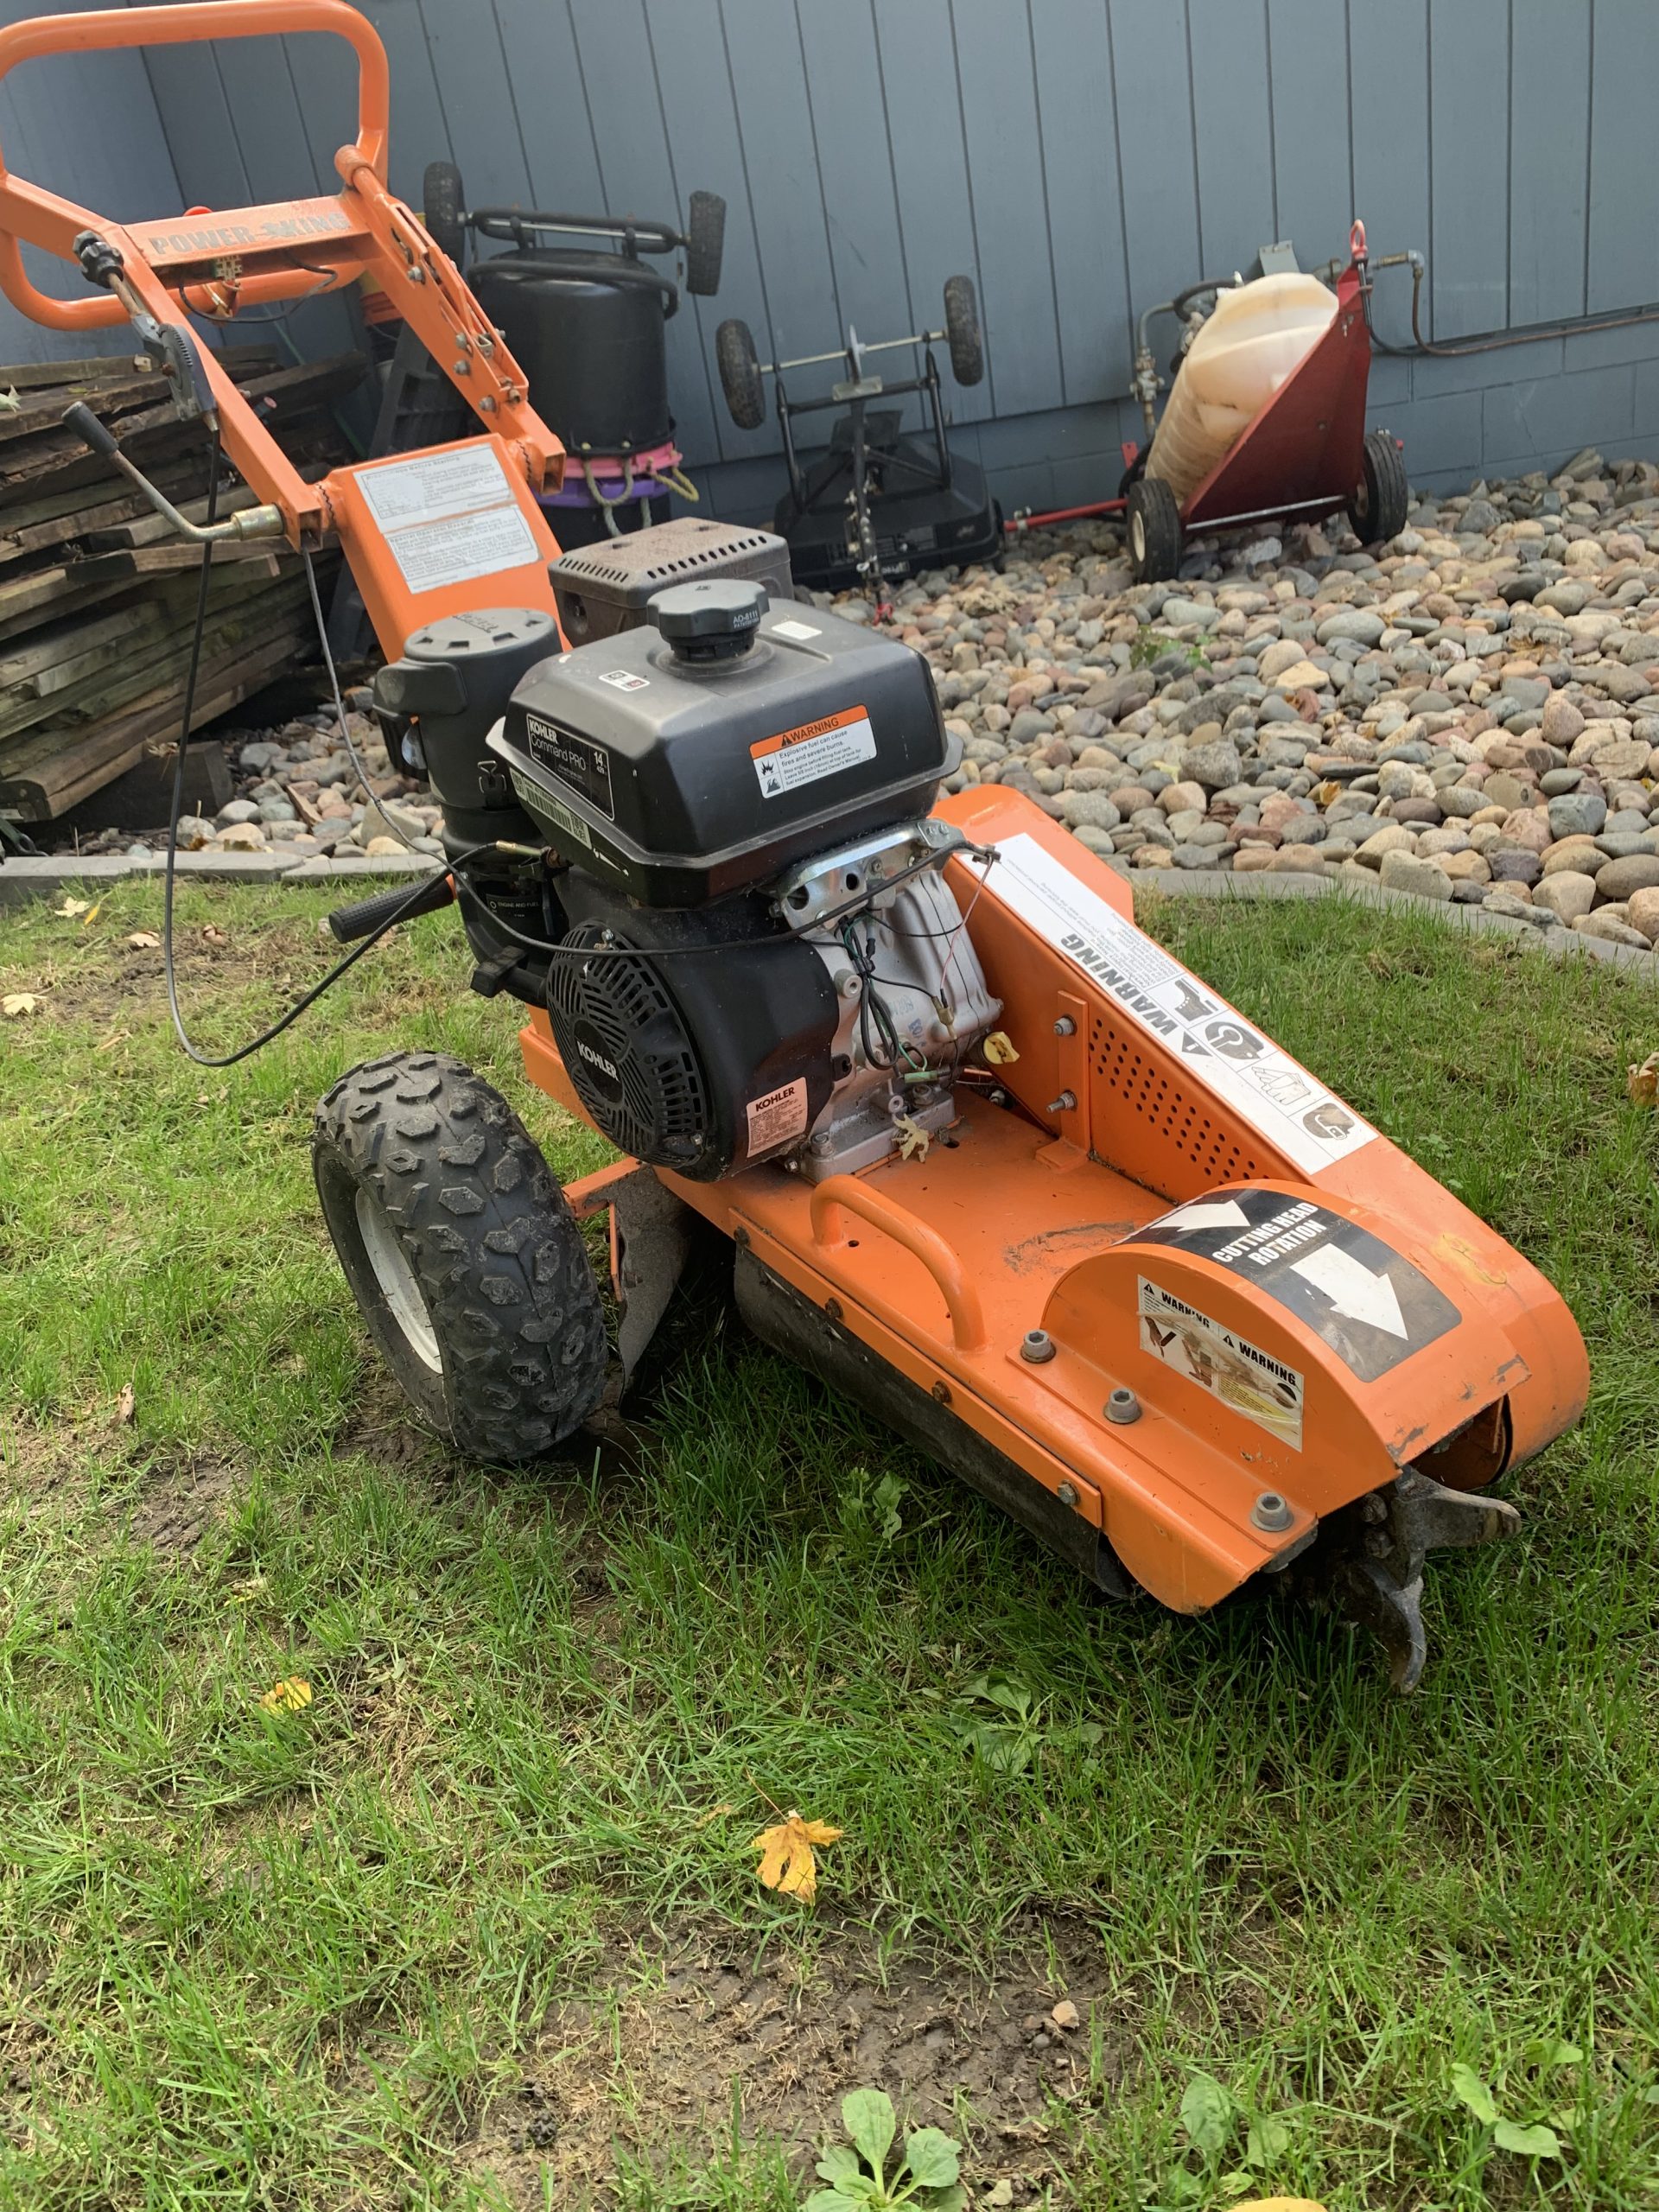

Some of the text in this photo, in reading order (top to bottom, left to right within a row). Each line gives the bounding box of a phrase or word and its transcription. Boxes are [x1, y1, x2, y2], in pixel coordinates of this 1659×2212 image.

[149, 226, 256, 256] POWER
[529, 719, 559, 745] KOHLER
[779, 729, 847, 759] Explosive fuel can cause
[790, 717, 839, 742] WARNING
[531, 733, 586, 771] Command PRO
[594, 751, 604, 766] 14
[781, 757, 794, 767] fires
[794, 753, 806, 762] and
[806, 746, 826, 758] severe
[793, 762, 808, 771] engine
[808, 756, 821, 765] before
[1059, 933, 1178, 1034] WARNING
[577, 1040, 620, 1083] KOHLER
[756, 1087, 795, 1112] KOHLER
[1212, 1202, 1319, 1262] CUTTING HEAD
[1247, 1219, 1327, 1265] ROTATION
[1239, 1341, 1296, 1386] WARNING
